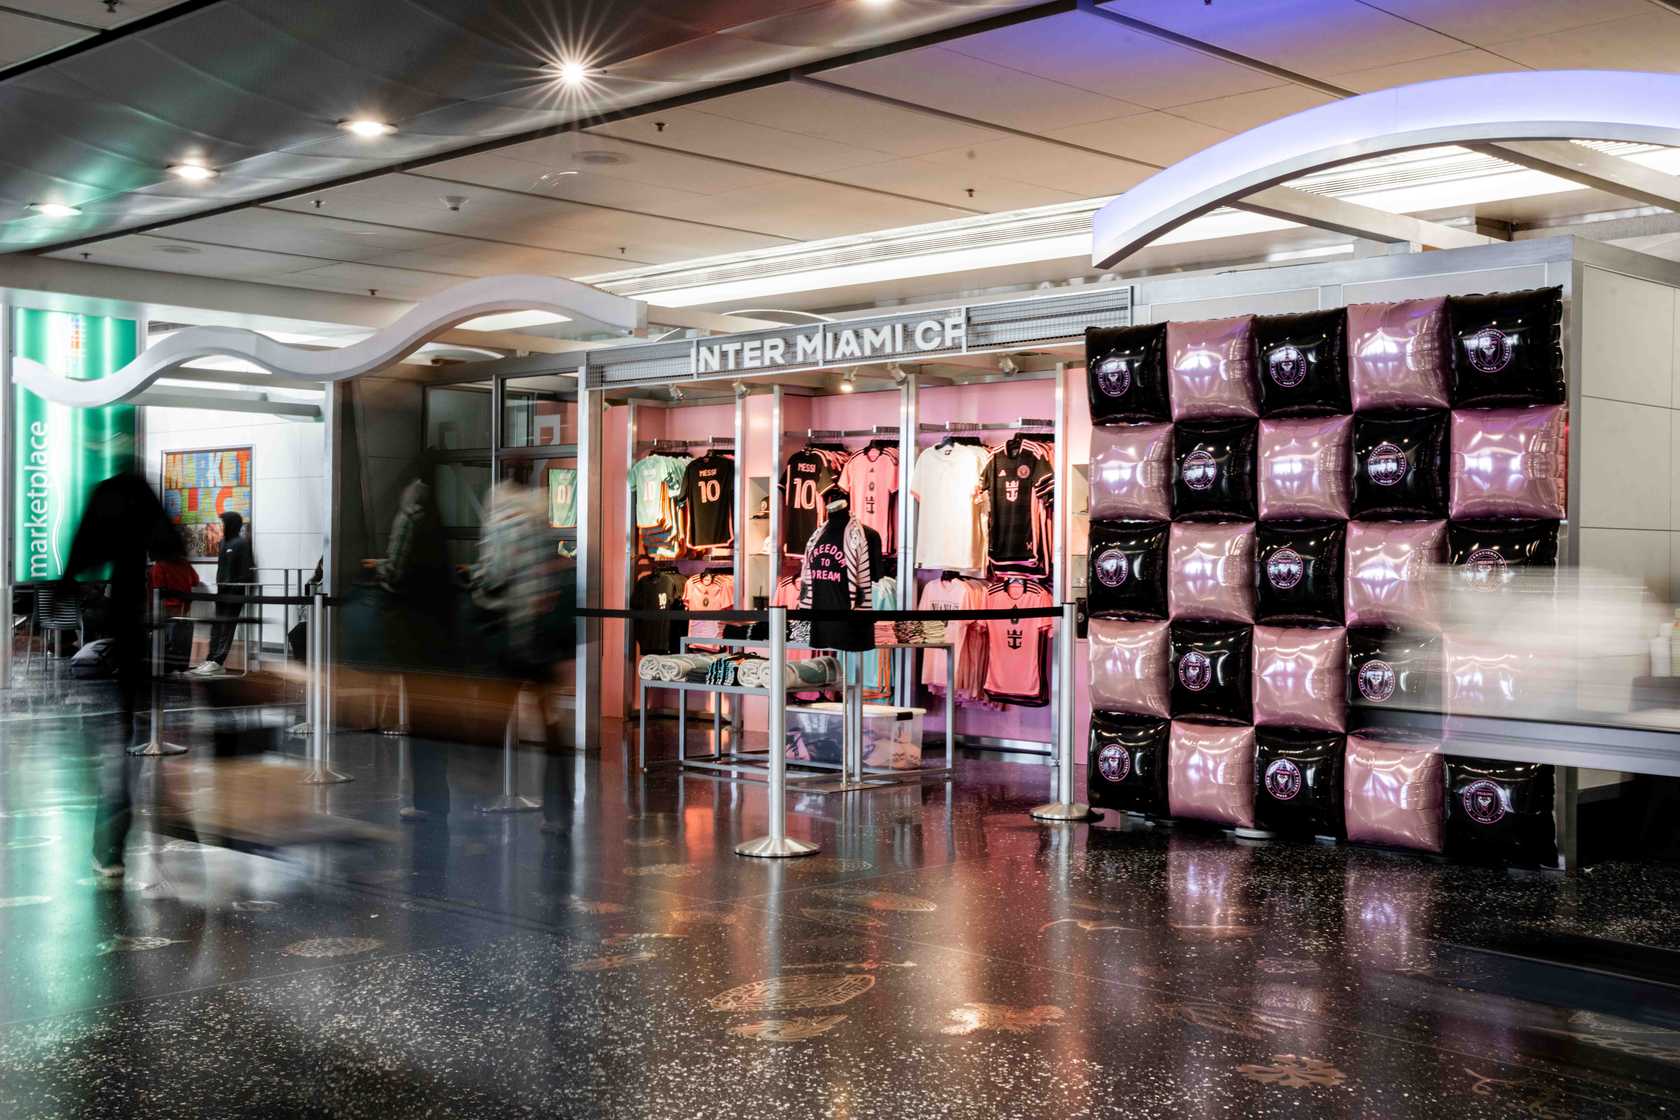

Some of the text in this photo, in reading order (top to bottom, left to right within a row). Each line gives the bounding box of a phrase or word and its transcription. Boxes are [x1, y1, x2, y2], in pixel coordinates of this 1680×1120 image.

[690, 338, 785, 374] INTER
[797, 323, 903, 362] MIAMI
[164, 449, 251, 489] MARKET
[798, 462, 816, 473] MESSI
[24, 421, 49, 578] marketplace
[698, 479, 721, 504] 10
[793, 478, 817, 510] 10
[821, 558, 830, 567] TO
